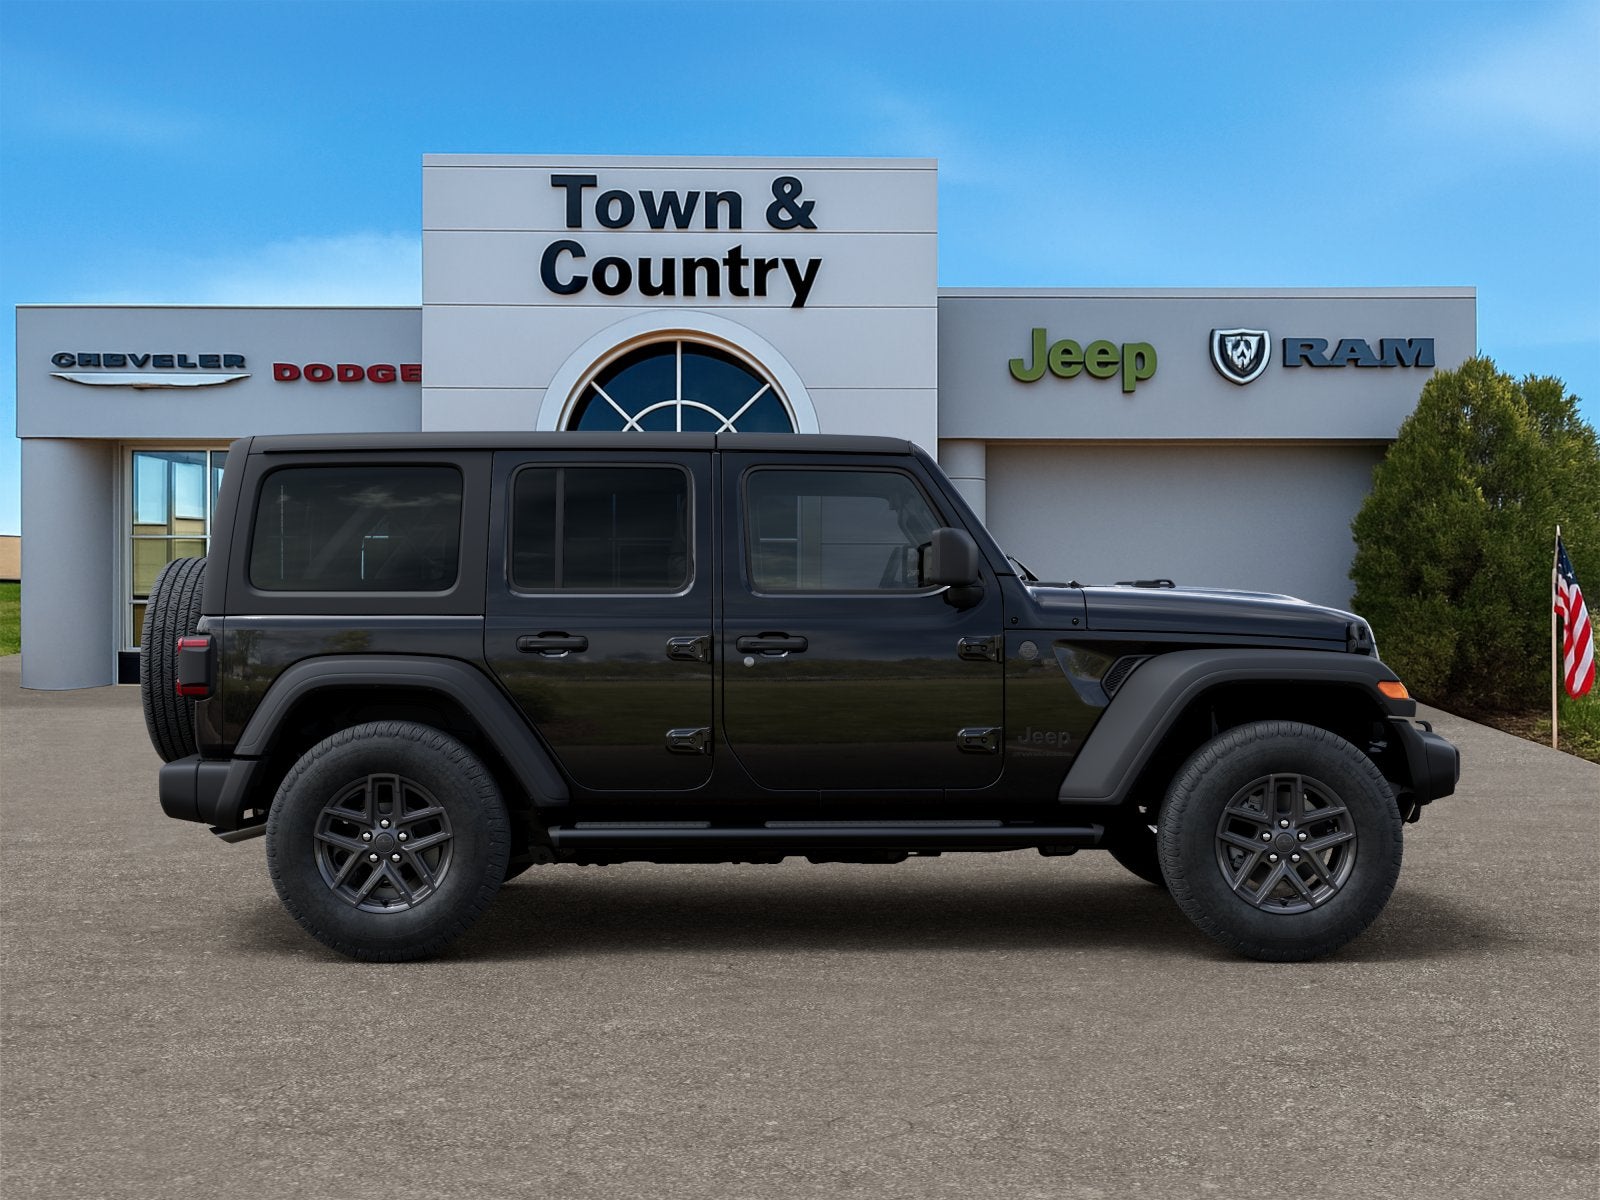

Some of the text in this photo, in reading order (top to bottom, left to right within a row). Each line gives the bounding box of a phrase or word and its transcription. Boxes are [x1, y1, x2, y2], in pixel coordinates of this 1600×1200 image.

[551, 174, 818, 230] Town &
[540, 239, 822, 308] Country
[273, 363, 422, 383] DODGE
[1009, 328, 1158, 393] Jeep
[1282, 337, 1436, 368] RAM
[1017, 726, 1072, 748] Jeep
